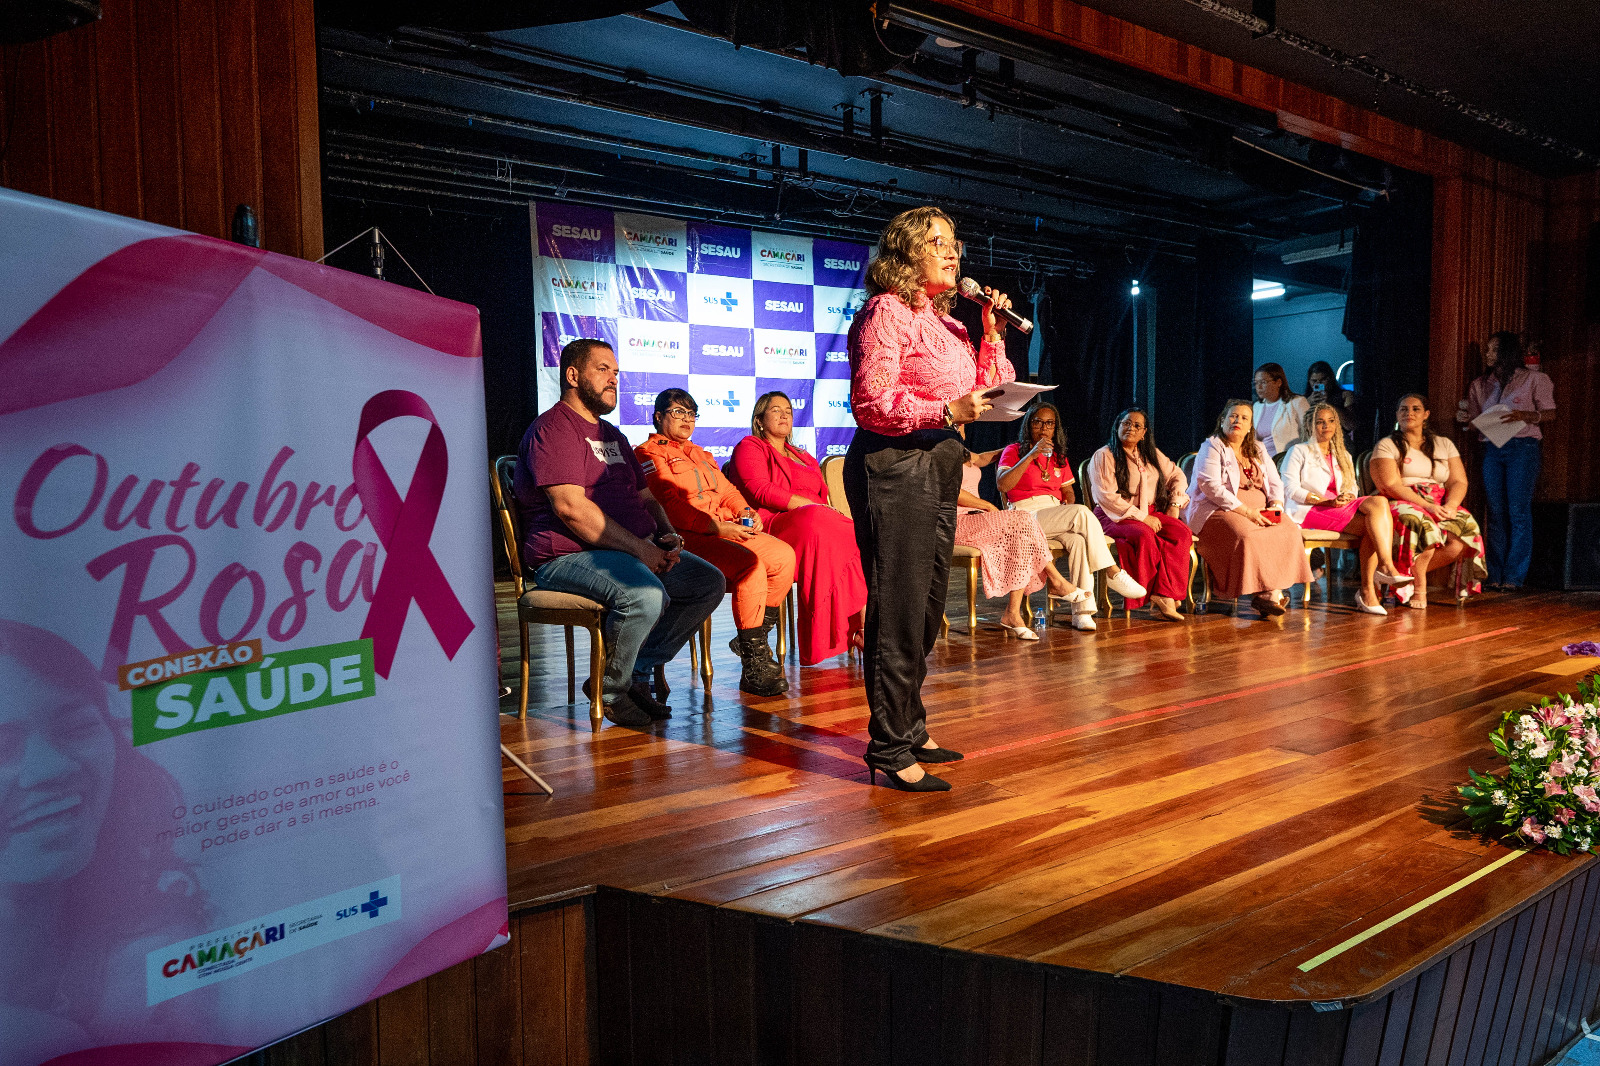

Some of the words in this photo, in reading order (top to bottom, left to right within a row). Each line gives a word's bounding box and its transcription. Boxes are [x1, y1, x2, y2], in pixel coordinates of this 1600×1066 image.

[552, 224, 601, 241] SESAU
[625, 231, 678, 247] CAMAÇARI
[700, 243, 740, 258] SESAU
[760, 249, 805, 262] CAMAÇARI
[823, 258, 860, 272] SESAU
[551, 277, 607, 291] CAMAÇARI
[632, 286, 676, 302] SESAU
[703, 296, 719, 305] SUS
[764, 299, 804, 313] SESAU
[827, 306, 842, 315] SUS
[628, 337, 680, 350] CAMAÇARI
[701, 344, 744, 358] SESAU
[763, 346, 807, 357] CAMAÇARI
[705, 398, 721, 406] SUS
[828, 400, 842, 408] SUS
[14, 443, 366, 540] Outubro
[85, 533, 378, 685] Rosa
[127, 643, 253, 687] CONEXÃO
[154, 653, 364, 731] SAÚDE
[172, 805, 187, 820] O
[192, 790, 269, 816] cuidado
[273, 780, 311, 797] com
[314, 777, 324, 788] a
[328, 764, 375, 785] saúde
[378, 761, 387, 773] é
[390, 760, 399, 770] o
[155, 819, 212, 841] maior
[216, 807, 269, 831] gesto
[273, 799, 294, 814] de
[299, 789, 342, 808] amor
[345, 782, 375, 798] que
[378, 769, 411, 788] você
[200, 828, 250, 852] pode
[254, 820, 284, 837] dar
[287, 816, 297, 827] a
[301, 809, 314, 824] si
[318, 797, 380, 820] mesma.
[336, 905, 358, 920] SUS
[162, 923, 286, 978] CAMAÇARI
